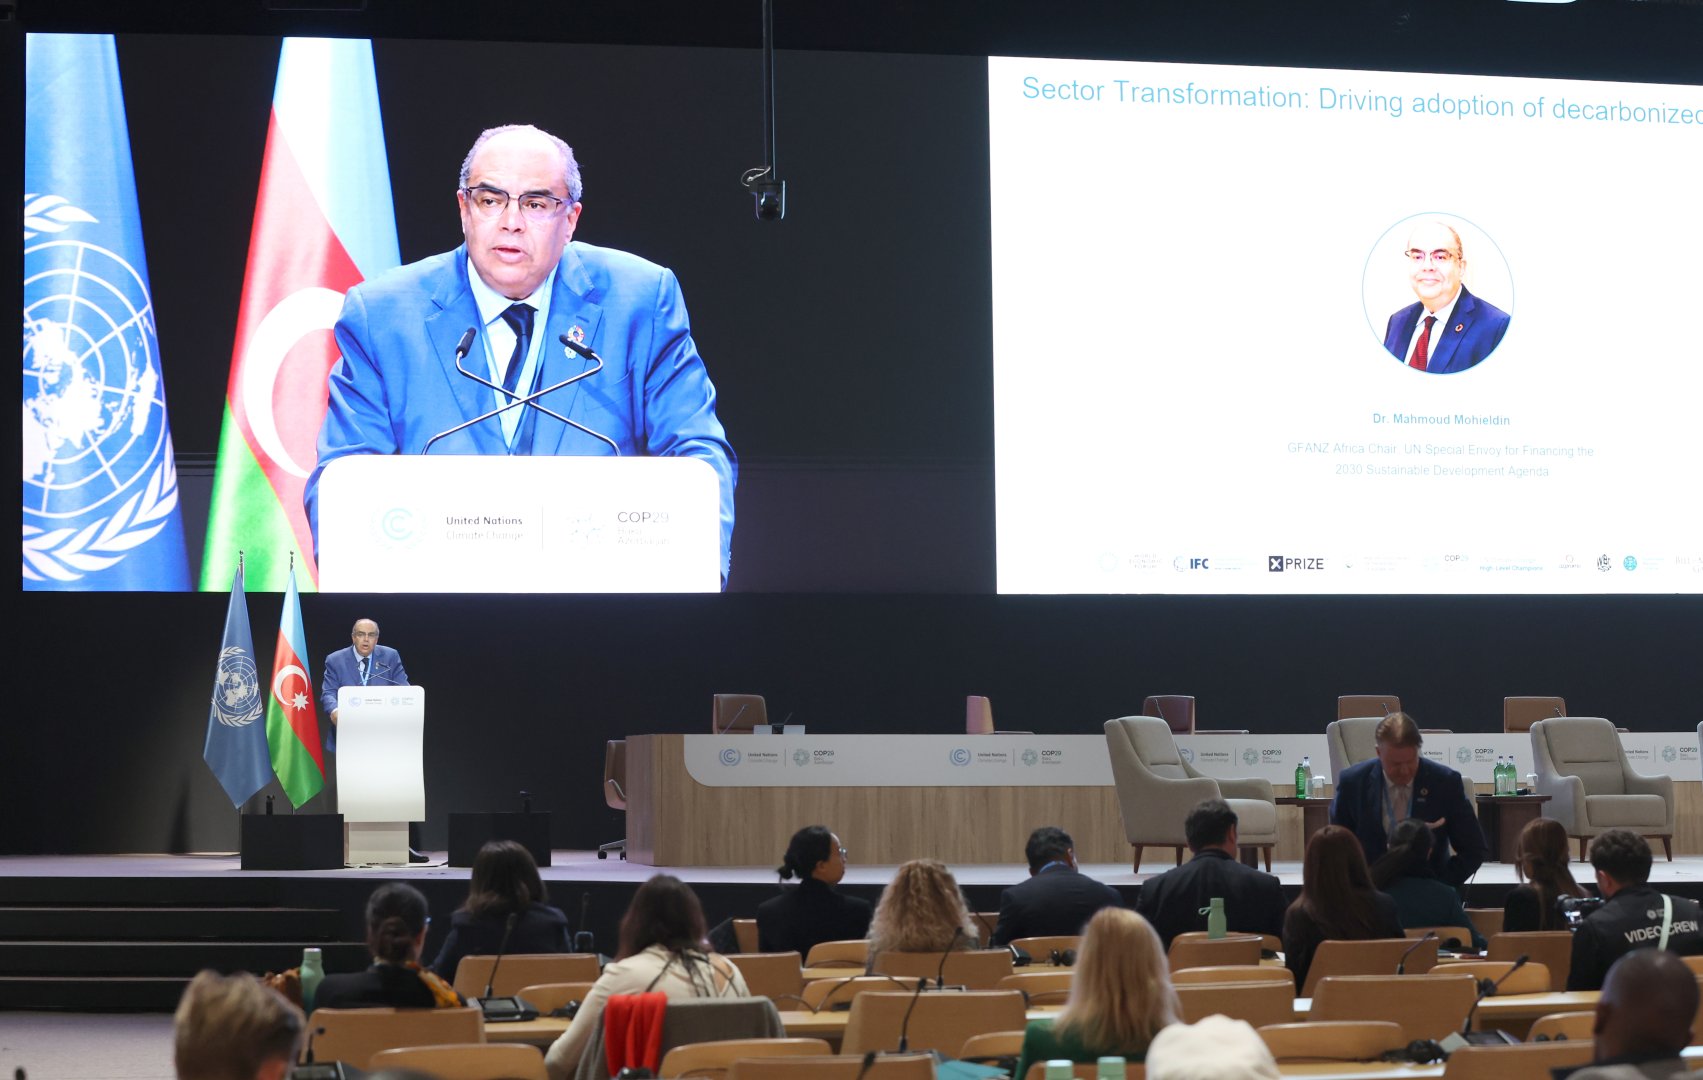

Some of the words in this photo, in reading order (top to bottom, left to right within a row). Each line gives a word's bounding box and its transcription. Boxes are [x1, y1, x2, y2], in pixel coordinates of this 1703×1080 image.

[1023, 76, 1105, 101] Sector
[1113, 79, 1309, 108] Transformation:
[1319, 87, 1403, 118] Driving
[1412, 93, 1514, 120] adoption
[1523, 96, 1545, 118] of
[1373, 413, 1390, 424] Dr.
[1393, 413, 1450, 425] Mahmoud
[1454, 414, 1510, 426] Mohieldin
[1287, 442, 1329, 454] GFANZ
[1333, 443, 1365, 454] Africa
[1404, 444, 1421, 455] UN
[1425, 444, 1465, 457] Special
[1468, 445, 1501, 458] Envoy
[1504, 445, 1519, 456] for
[1522, 445, 1574, 458] Financing
[1577, 446, 1594, 457] the
[1335, 464, 1362, 475] 2030
[1366, 464, 1429, 476] Sustainable
[1433, 465, 1504, 478] Development
[1508, 466, 1549, 479] Agenda
[446, 516, 480, 525] United
[483, 516, 523, 525] Nations
[617, 511, 669, 523] COP29
[1190, 558, 1209, 570] IFC
[1624, 925, 1662, 943] VIDEO
